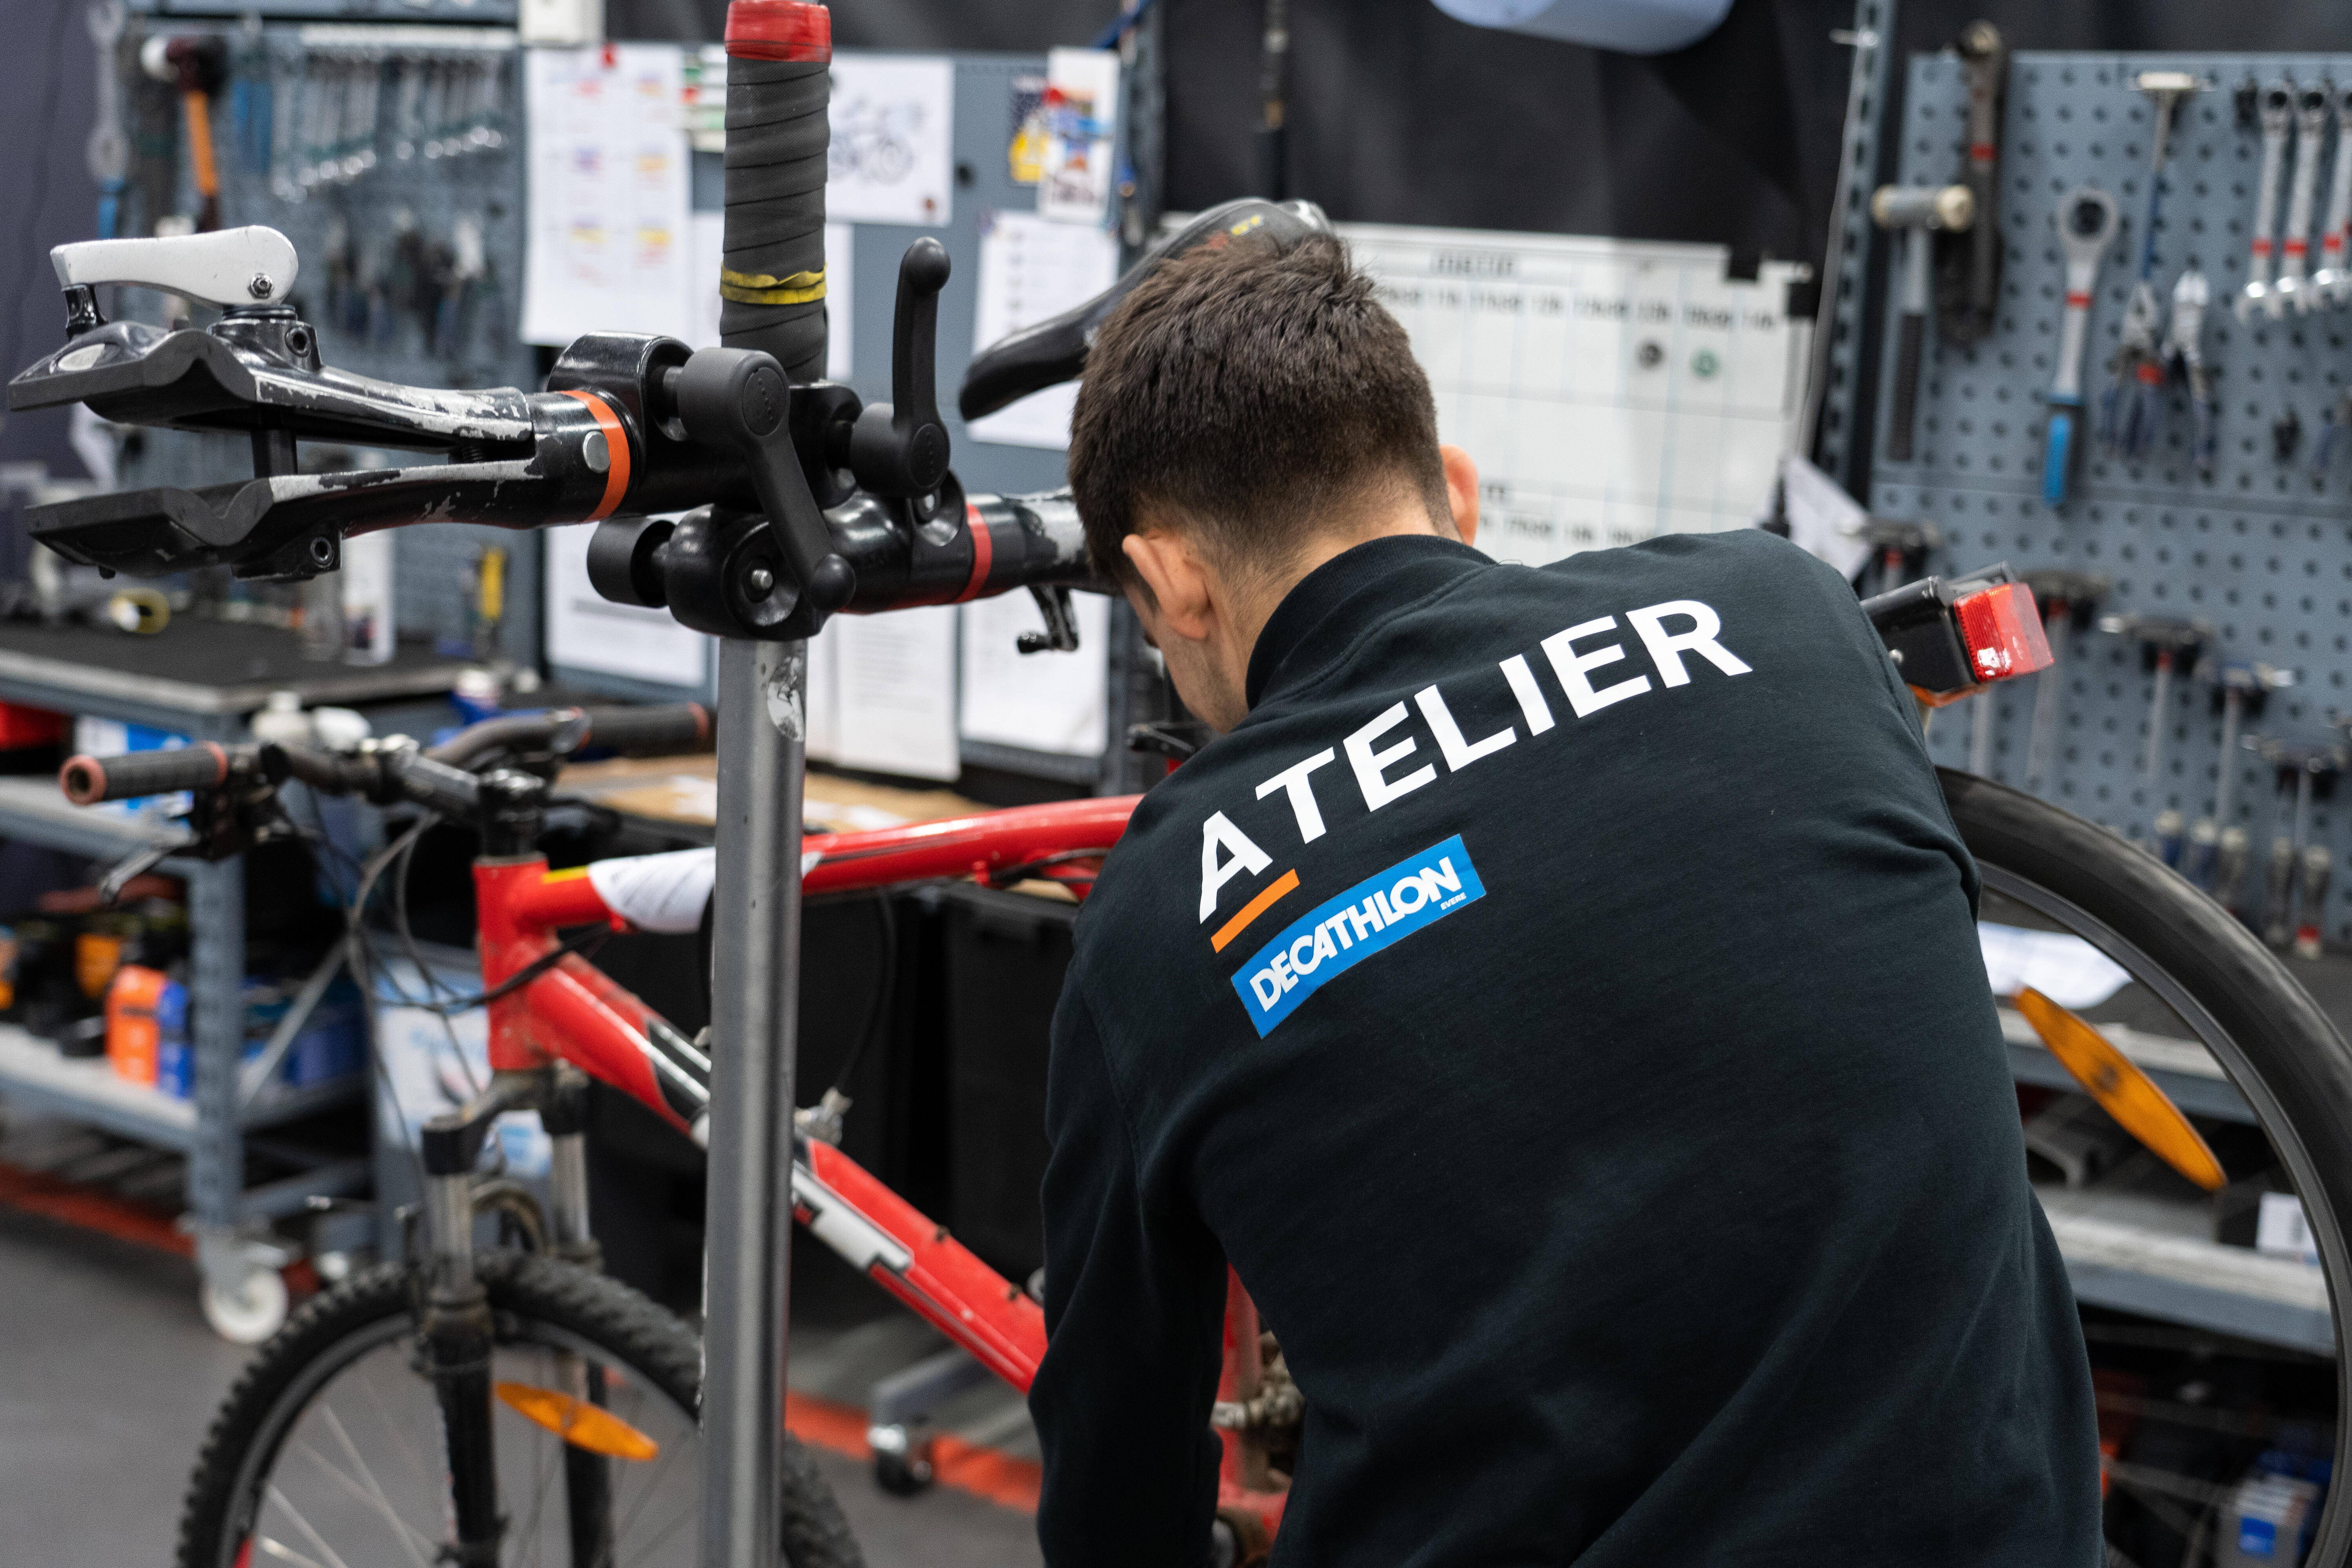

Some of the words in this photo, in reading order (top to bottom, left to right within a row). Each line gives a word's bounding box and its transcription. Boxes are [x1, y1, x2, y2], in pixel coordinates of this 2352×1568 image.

[1199, 599, 1753, 924] ATELIER
[1249, 856, 1462, 1012] DECATHLON
[1440, 892, 1467, 911] EVERE
